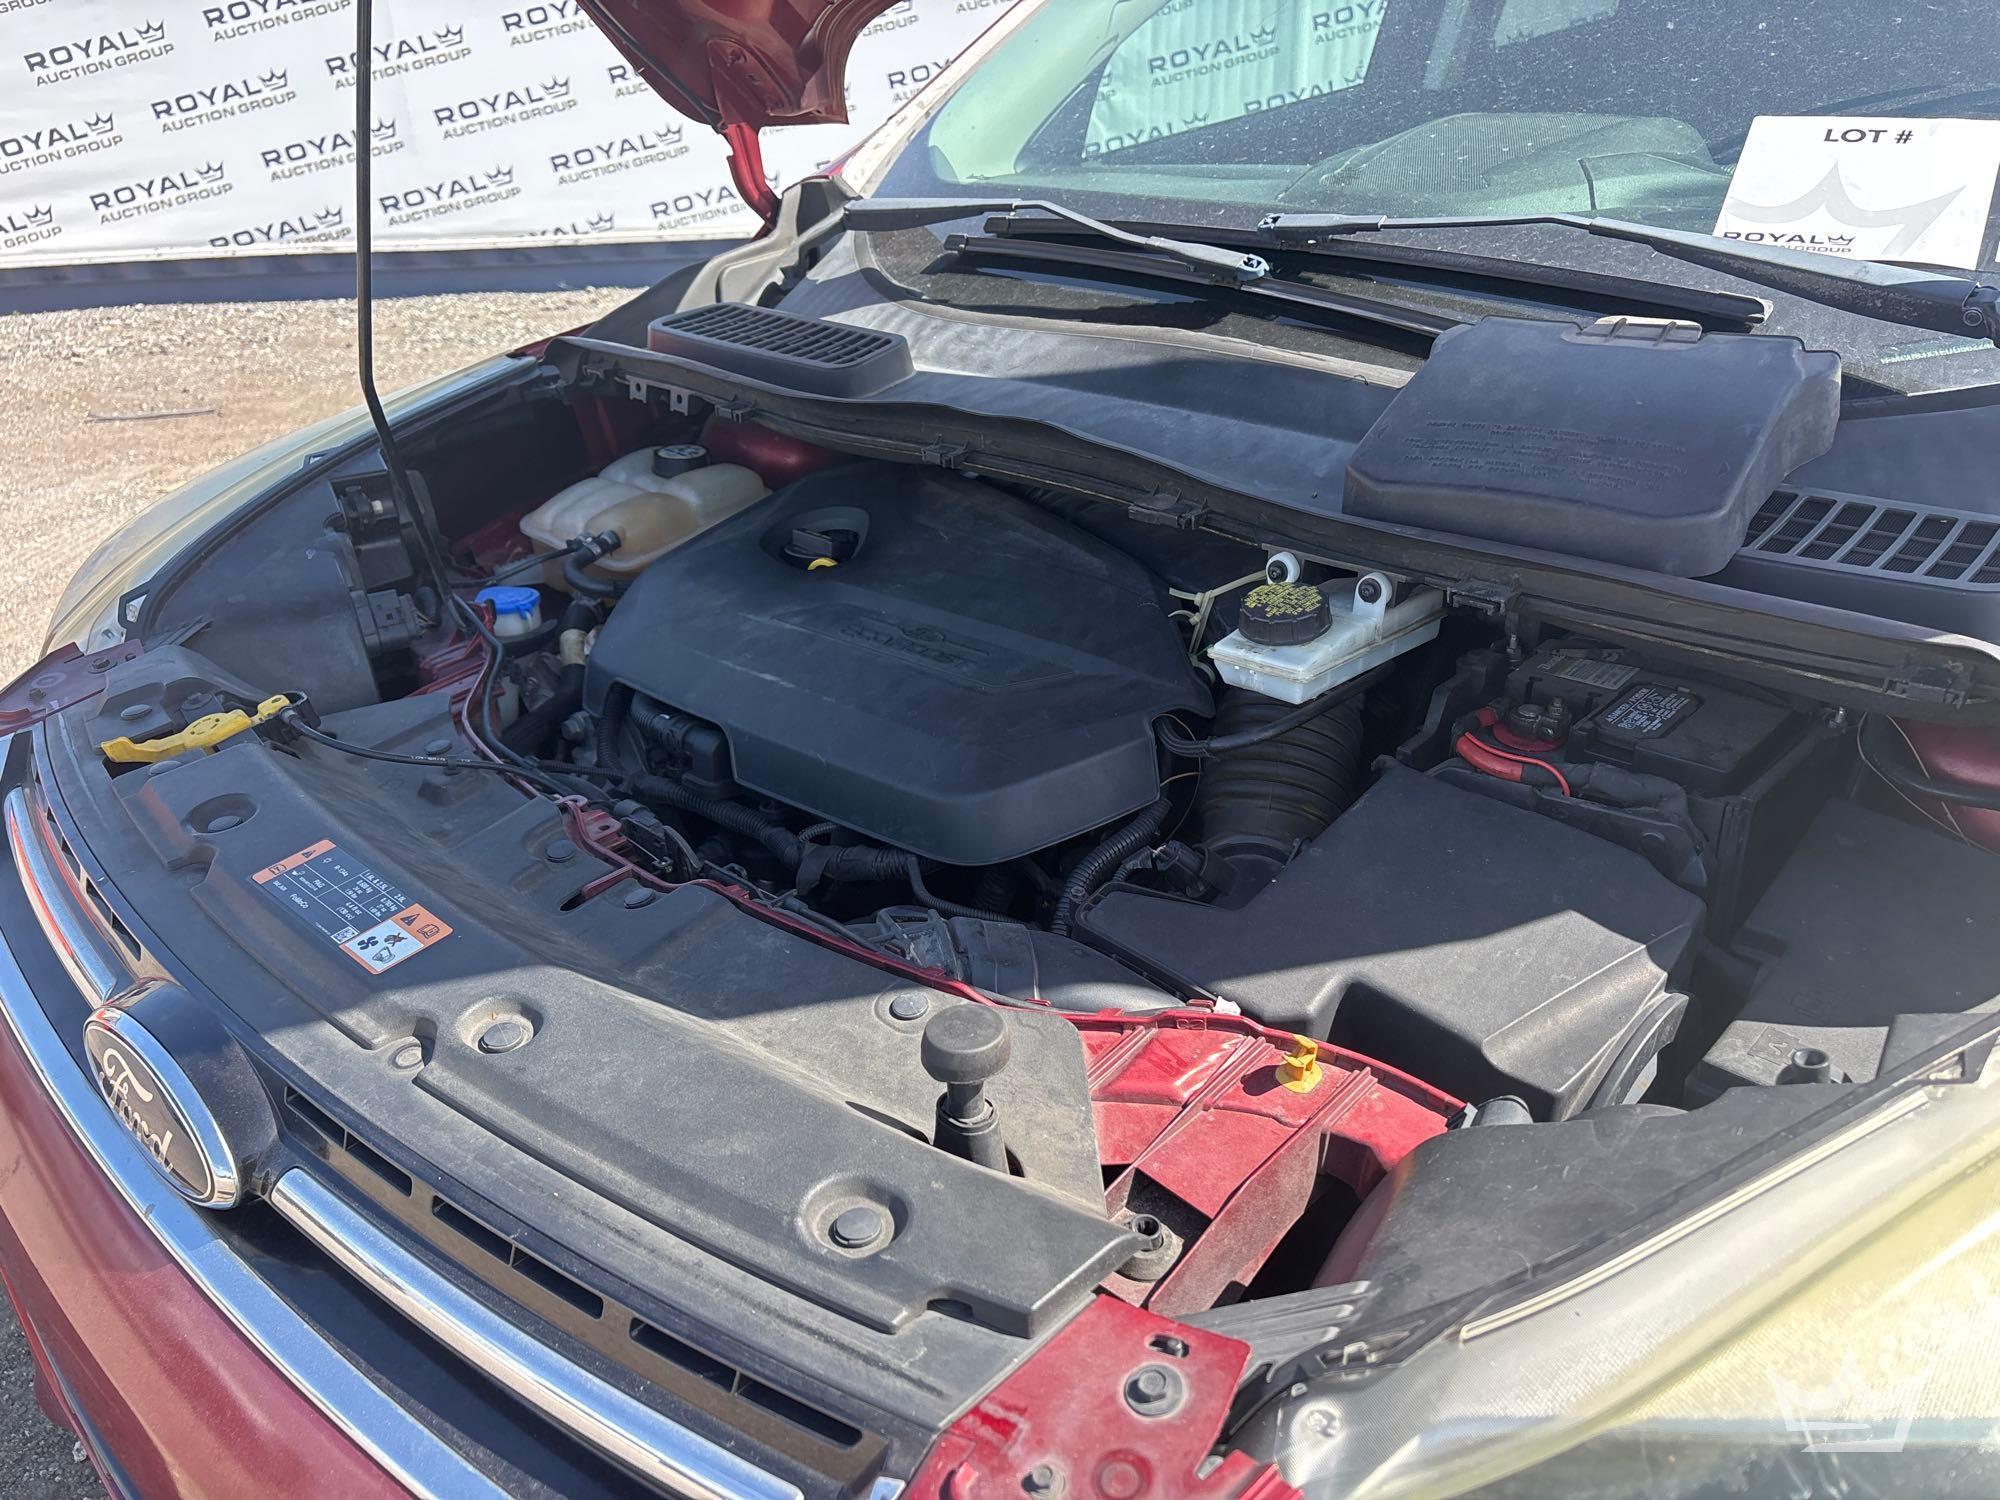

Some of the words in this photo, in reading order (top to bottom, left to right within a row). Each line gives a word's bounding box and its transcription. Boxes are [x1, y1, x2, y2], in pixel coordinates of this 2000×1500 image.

[203, 0, 317, 28] ROYA
[214, 13, 289, 42] AUCTION
[292, 0, 351, 22] GROUP
[510, 19, 585, 47] AUCTION
[23, 31, 139, 72] ROYAL
[36, 59, 112, 87] AUCTION
[115, 43, 174, 67] GROUP
[335, 62, 409, 90] AUTION
[412, 47, 472, 71] GROUP
[1148, 35, 1250, 74] ROYAL
[1152, 63, 1222, 88] AUCTION
[1225, 46, 1280, 69] GROUP
[151, 79, 262, 119] ROYAL
[162, 106, 235, 134] AUCTION
[238, 91, 297, 114] GROUP
[434, 87, 544, 126] ROYAL
[443, 112, 517, 141] AUCTION
[519, 99, 578, 122] GROUP
[1823, 128, 1888, 144] LOT
[1895, 130, 1914, 144] #
[0, 123, 88, 157] OYAL
[0, 150, 61, 174] UCTION
[64, 135, 123, 158] GROUP
[550, 134, 657, 173] ROYAL
[271, 156, 345, 182] AUCTION
[558, 160, 630, 185] AUCTION
[632, 145, 690, 168] GROUP
[89, 171, 199, 211] ROYAL
[100, 197, 173, 225] AUCTION
[175, 182, 234, 206] GROUP
[379, 175, 487, 214] ROYAL
[388, 200, 462, 227] AUCTION
[464, 186, 522, 210] GROUP
[651, 186, 736, 219] ROYA
[4, 226, 62, 249] GROUP
[657, 205, 727, 231] AUCTION
[1723, 231, 1825, 245] ROYAL
[287, 892, 311, 909] FoMoCo
[99, 1048, 175, 1174] Ford
